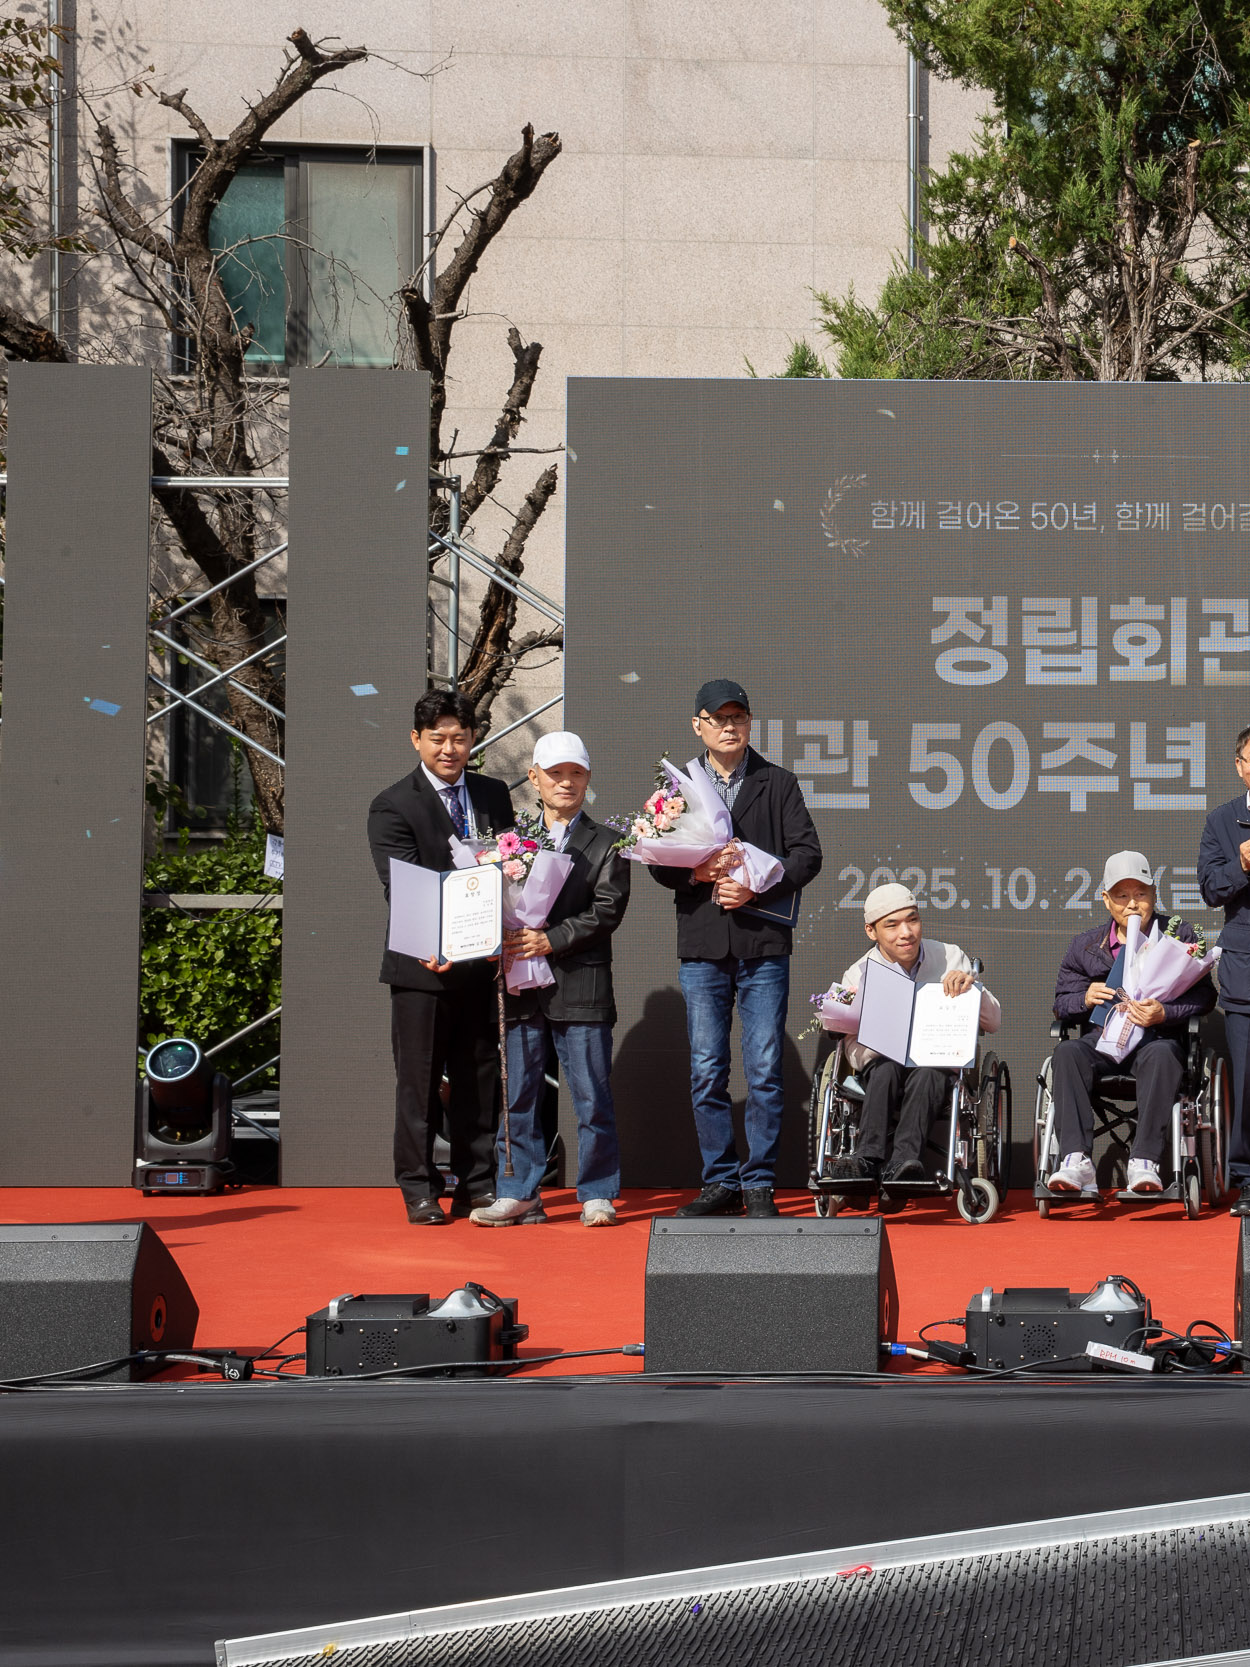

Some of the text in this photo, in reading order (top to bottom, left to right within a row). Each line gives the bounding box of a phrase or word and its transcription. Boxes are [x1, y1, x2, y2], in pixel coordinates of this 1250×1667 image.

[870, 500, 926, 530] 함께
[937, 500, 1021, 531] 걸어온
[1031, 501, 1104, 534] 50년,
[1115, 501, 1171, 532] 함께
[908, 721, 1207, 812] 50주년
[985, 867, 1049, 910] 10.
[1153, 866, 1224, 912] (금
